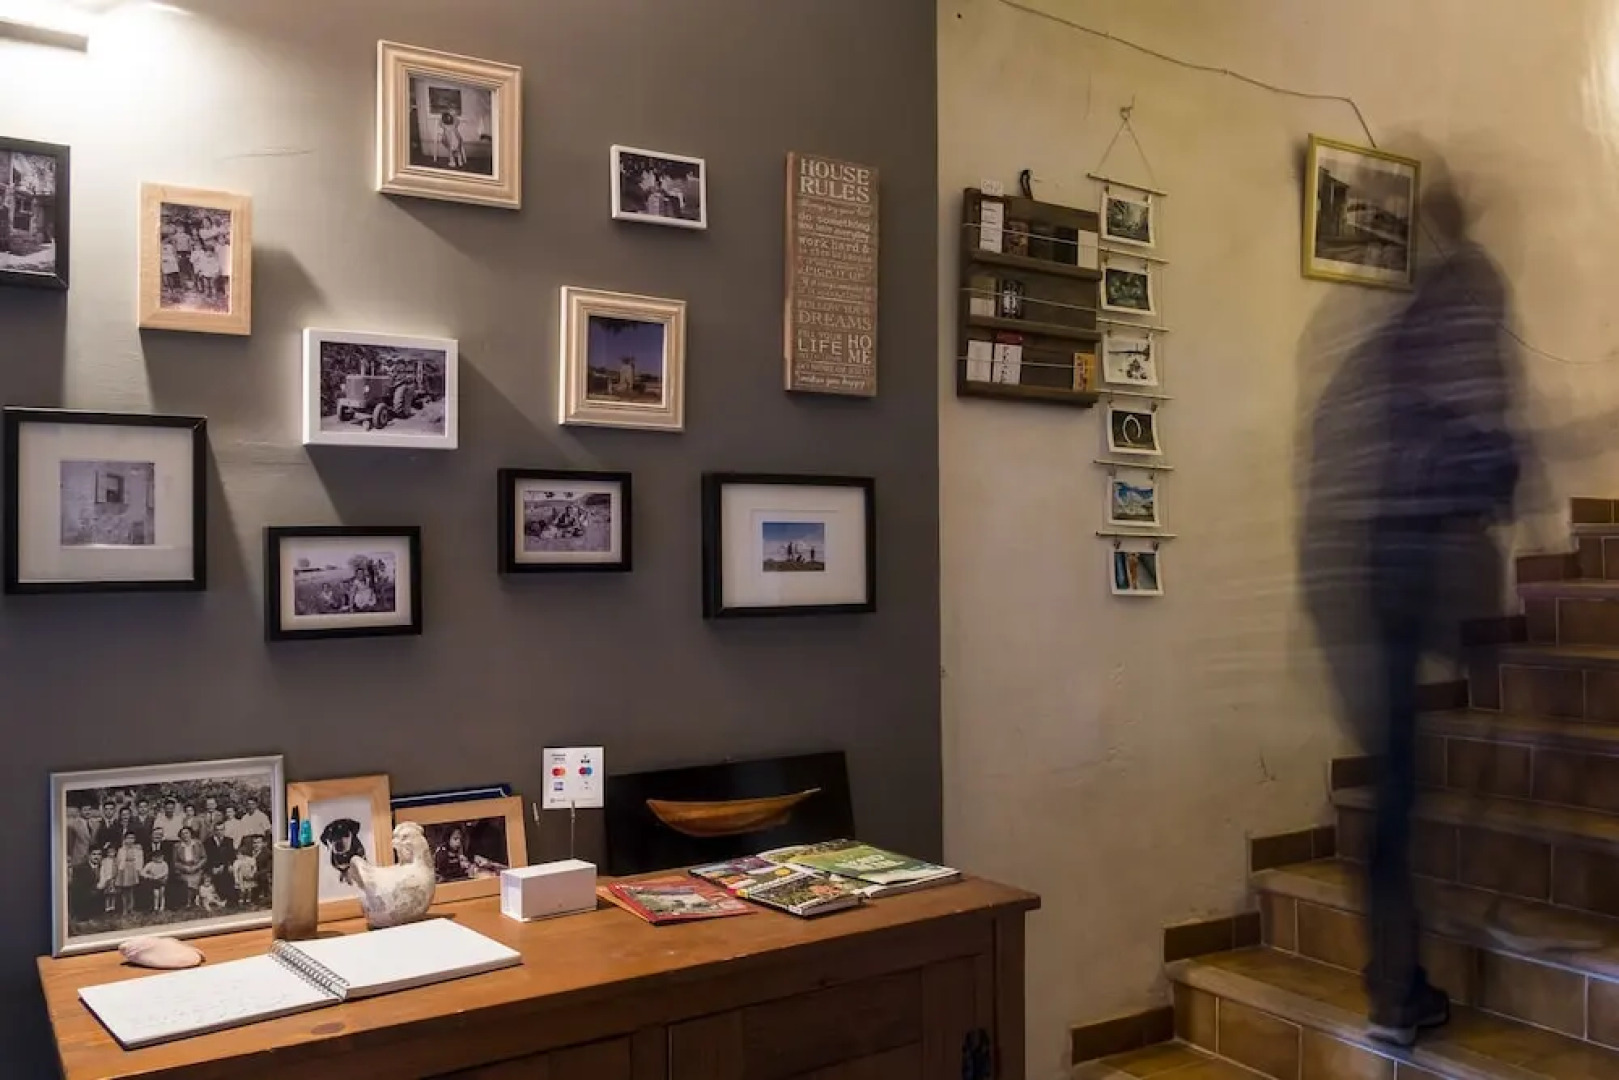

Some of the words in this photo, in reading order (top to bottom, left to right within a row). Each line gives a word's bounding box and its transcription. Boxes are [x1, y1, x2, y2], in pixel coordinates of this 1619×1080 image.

[801, 158, 870, 185] HOUSE
[801, 176, 870, 203] RULES
[799, 235, 829, 248] work
[832, 238, 859, 253] hard
[799, 310, 872, 331] DREAMS
[798, 337, 843, 356] LIFE
[848, 334, 872, 349] HO
[848, 349, 872, 364] ME
